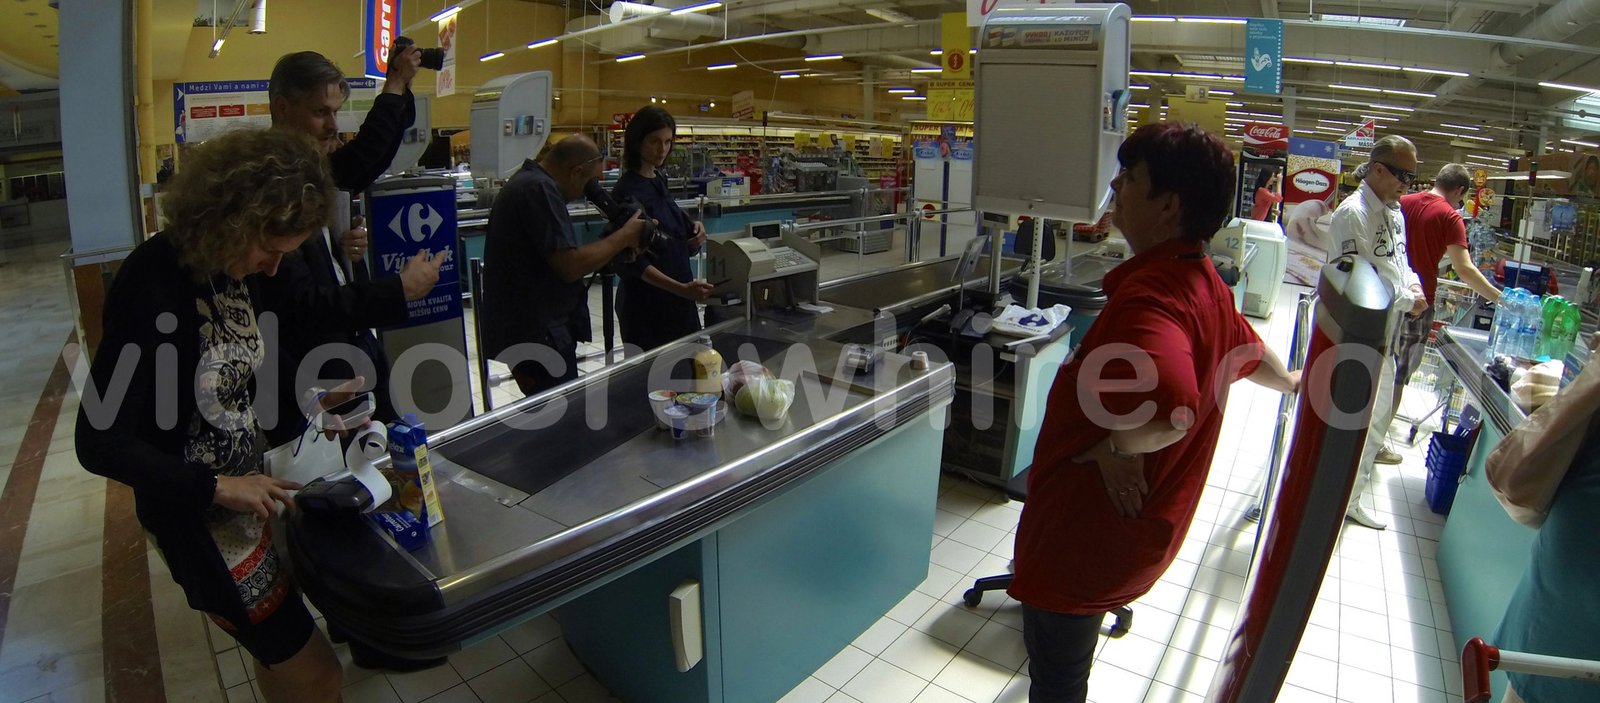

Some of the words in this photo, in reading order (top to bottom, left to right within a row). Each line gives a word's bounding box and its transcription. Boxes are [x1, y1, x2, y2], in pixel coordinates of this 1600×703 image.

[189, 84, 211, 92] Medzi
[213, 83, 232, 91] Vami
[241, 82, 259, 90] nami
[1249, 126, 1282, 139] Coca-Cola
[1225, 236, 1239, 250] 12
[710, 255, 726, 278] 11
[428, 294, 452, 306] KVALITA
